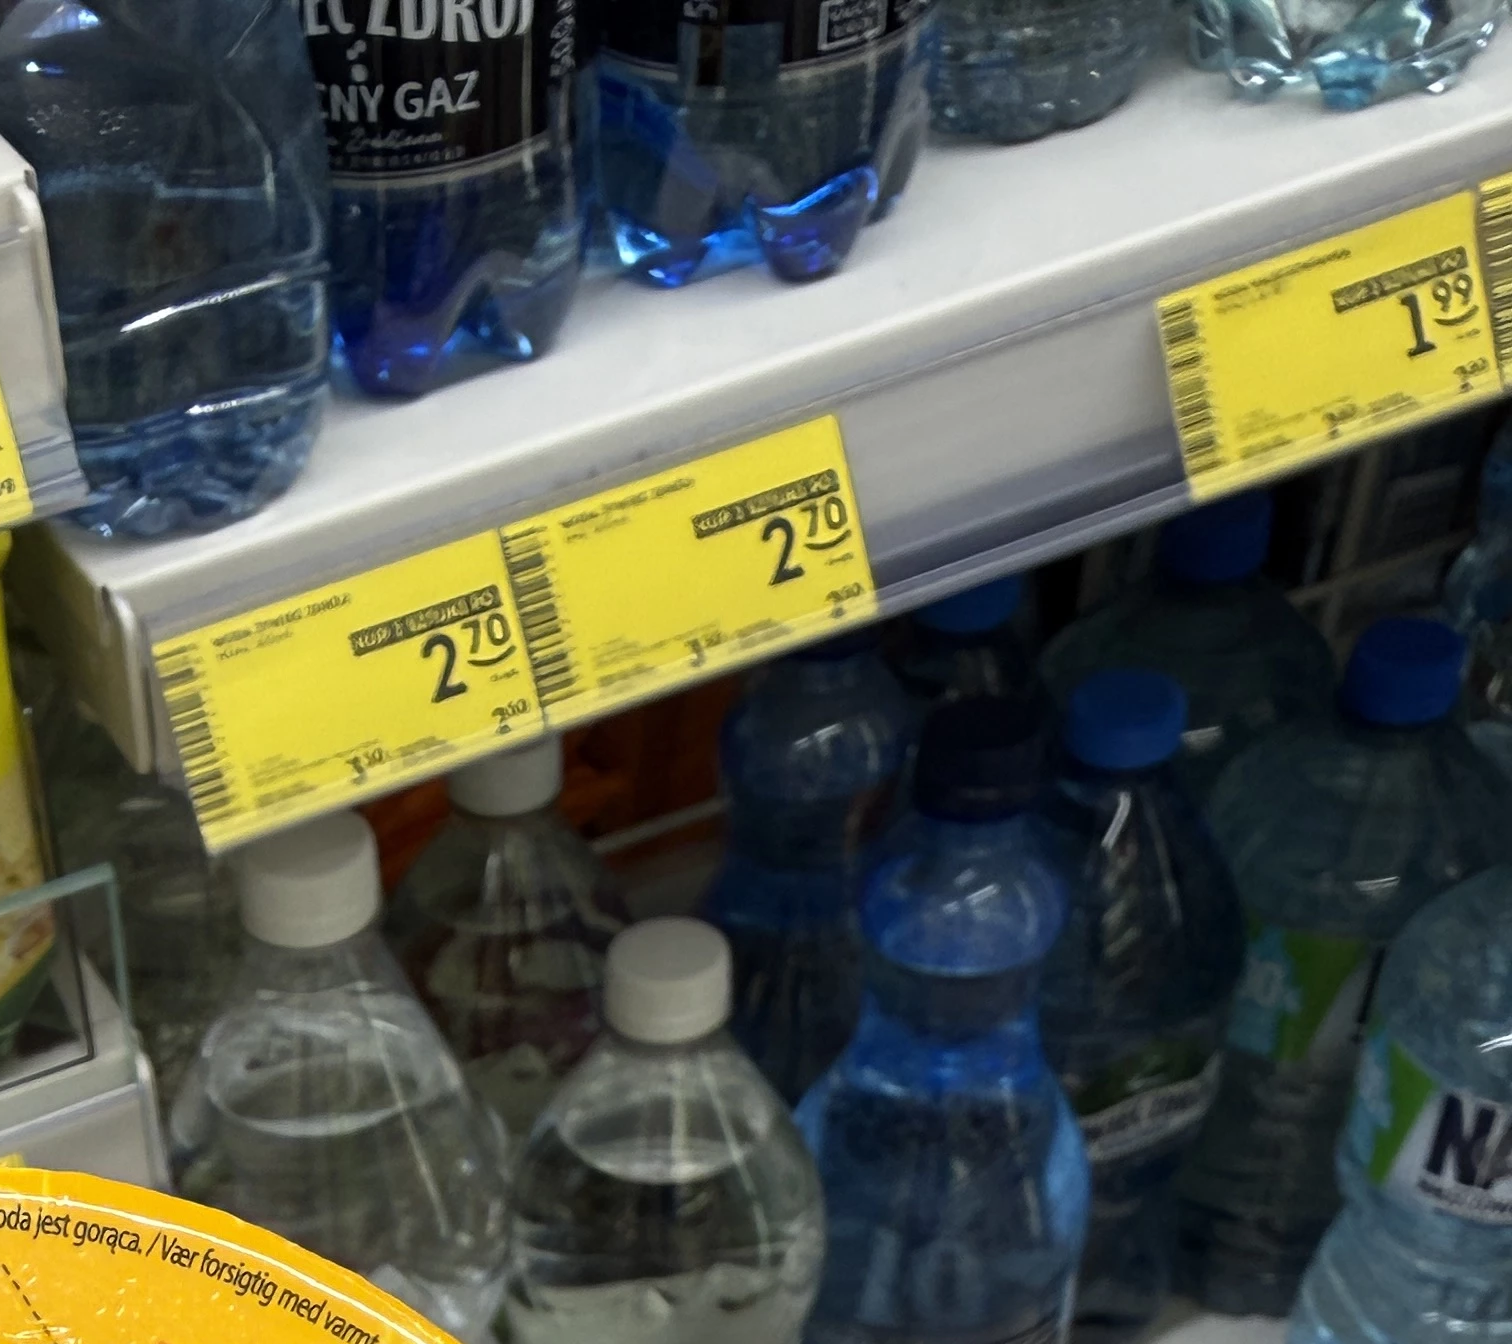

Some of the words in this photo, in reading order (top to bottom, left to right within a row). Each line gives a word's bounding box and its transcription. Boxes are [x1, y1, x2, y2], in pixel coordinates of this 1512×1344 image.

[393, 69, 481, 120] GAZ
[33, 1206, 70, 1240] jest
[73, 1218, 143, 1256] gorąca.
[160, 1233, 201, 1270] Vær
[199, 1247, 278, 1307] forsigtig
[277, 1286, 328, 1325] med
